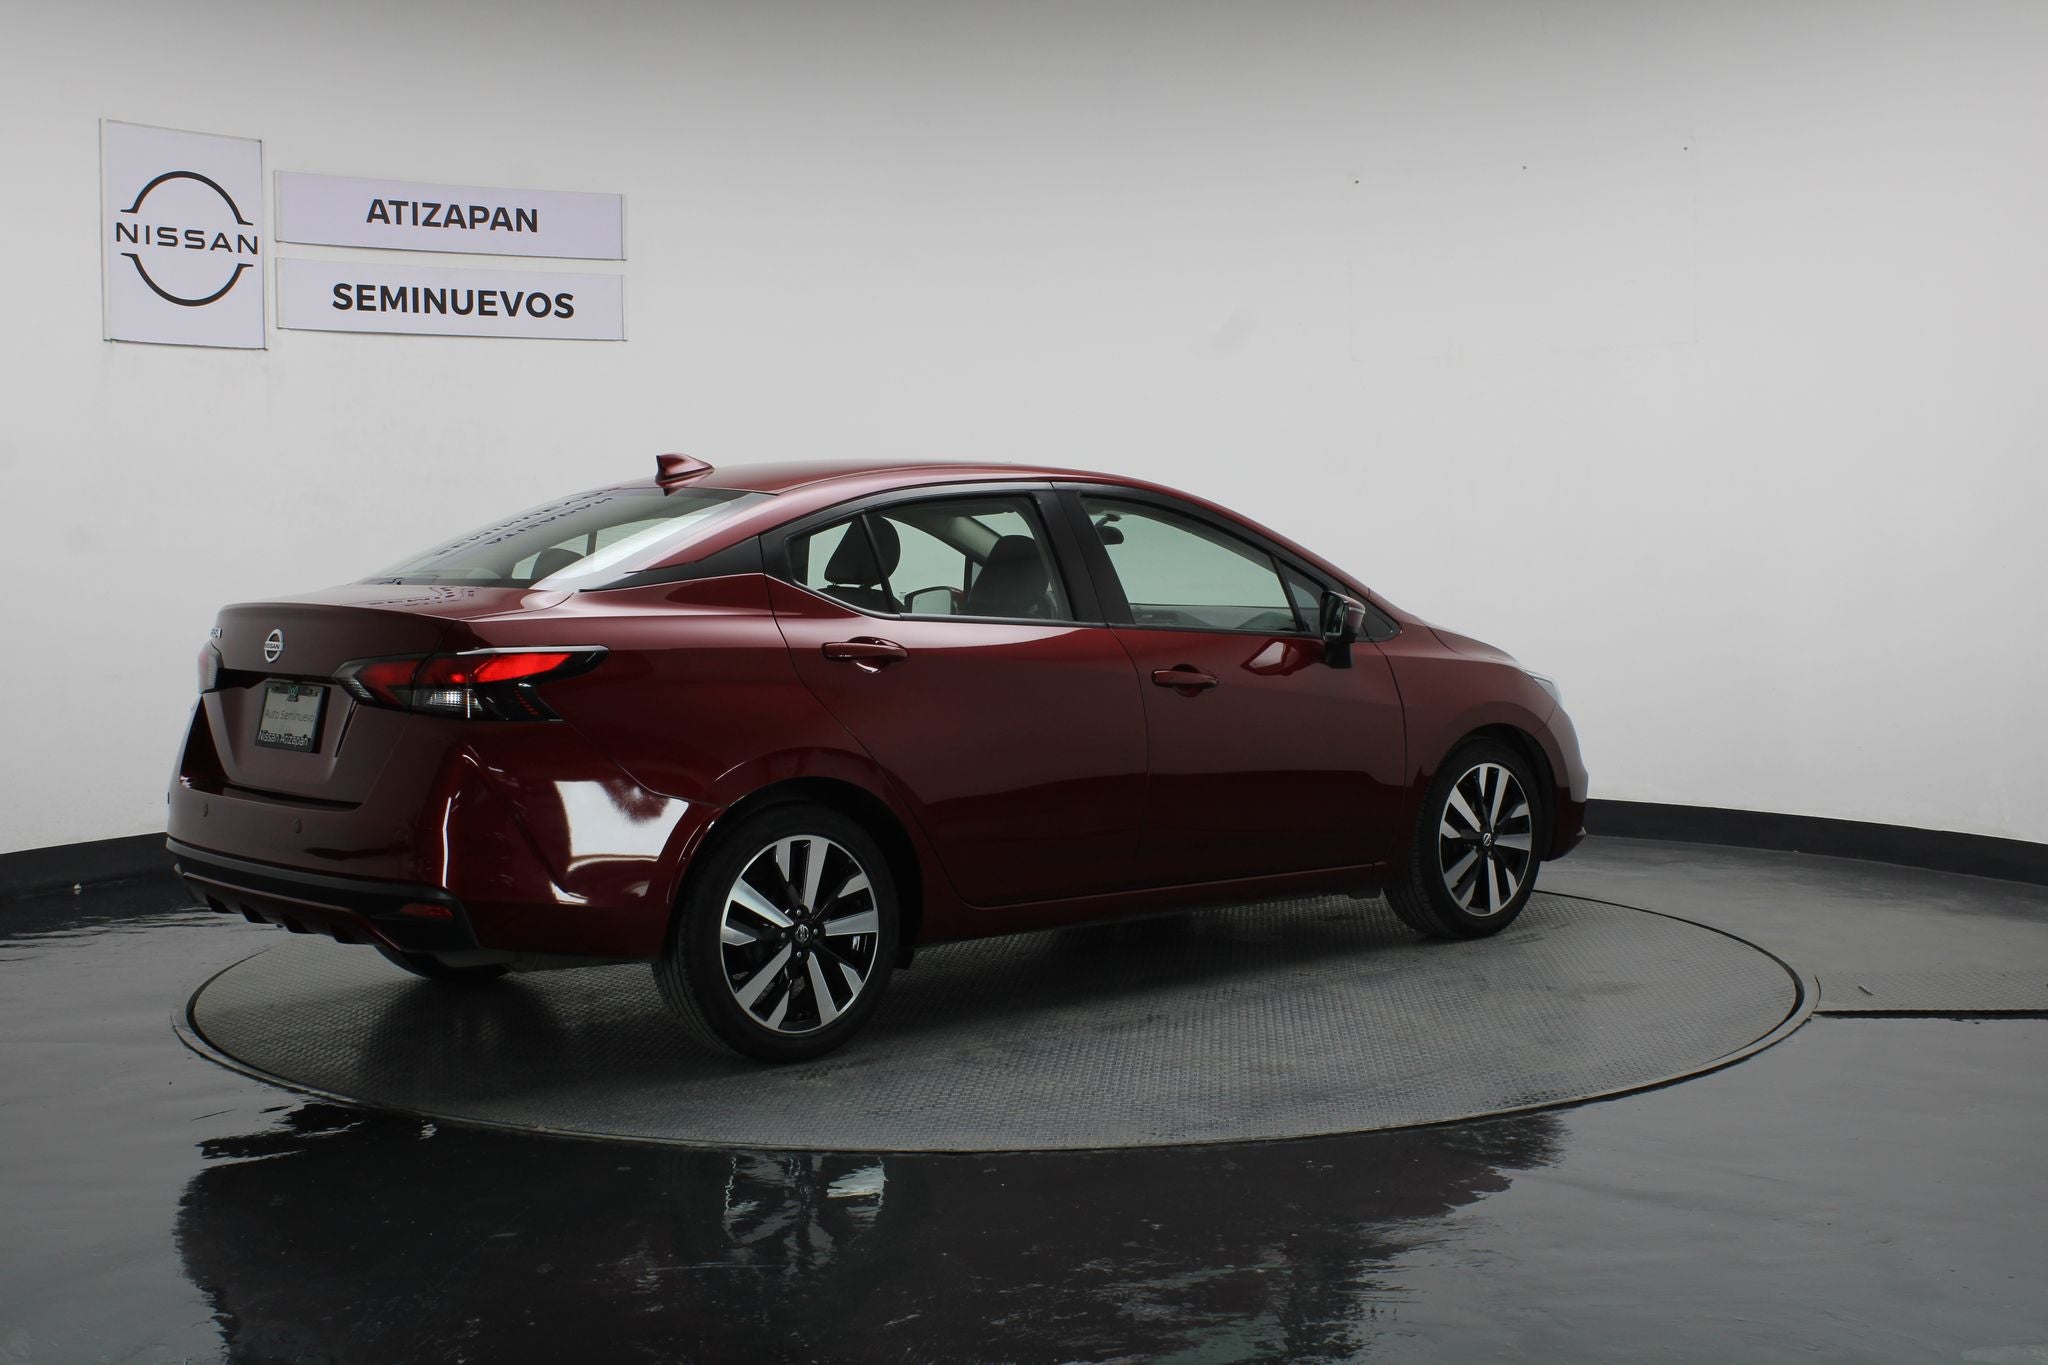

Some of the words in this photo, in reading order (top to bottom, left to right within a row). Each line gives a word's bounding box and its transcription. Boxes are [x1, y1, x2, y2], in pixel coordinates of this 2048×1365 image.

[366, 198, 538, 233] ATIZAPAN
[116, 222, 258, 255] NISSAN
[332, 282, 575, 319] SEMINUEVOS
[258, 730, 280, 742] Nissan
